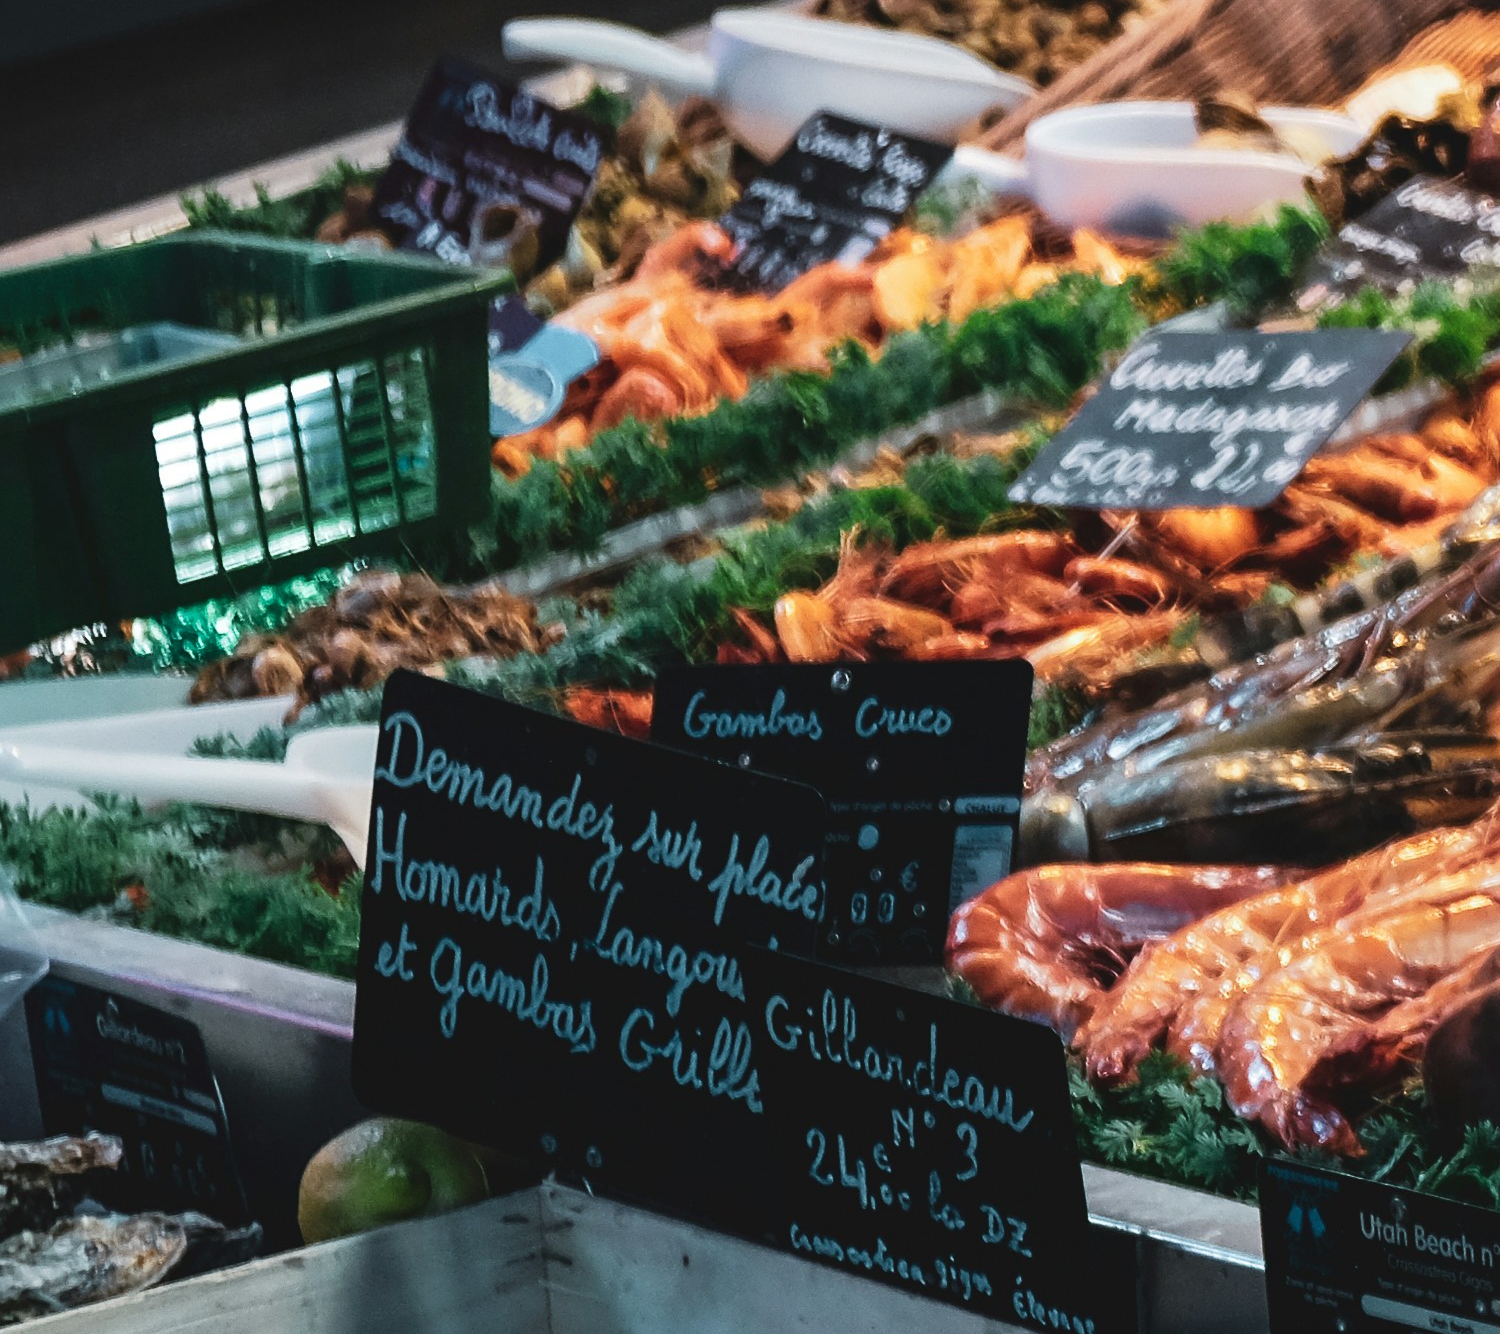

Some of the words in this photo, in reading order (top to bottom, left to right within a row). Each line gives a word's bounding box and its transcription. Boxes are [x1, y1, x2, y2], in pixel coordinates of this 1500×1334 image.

[684, 688, 824, 741] Gambas
[377, 712, 622, 891] Demandez
[632, 815, 703, 881] sur
[374, 928, 417, 981] et
[765, 989, 1035, 1133] Gillardeau
[956, 1121, 979, 1181] 3
[1359, 1210, 1409, 1248] Utah
[1413, 1224, 1477, 1265] Beach
